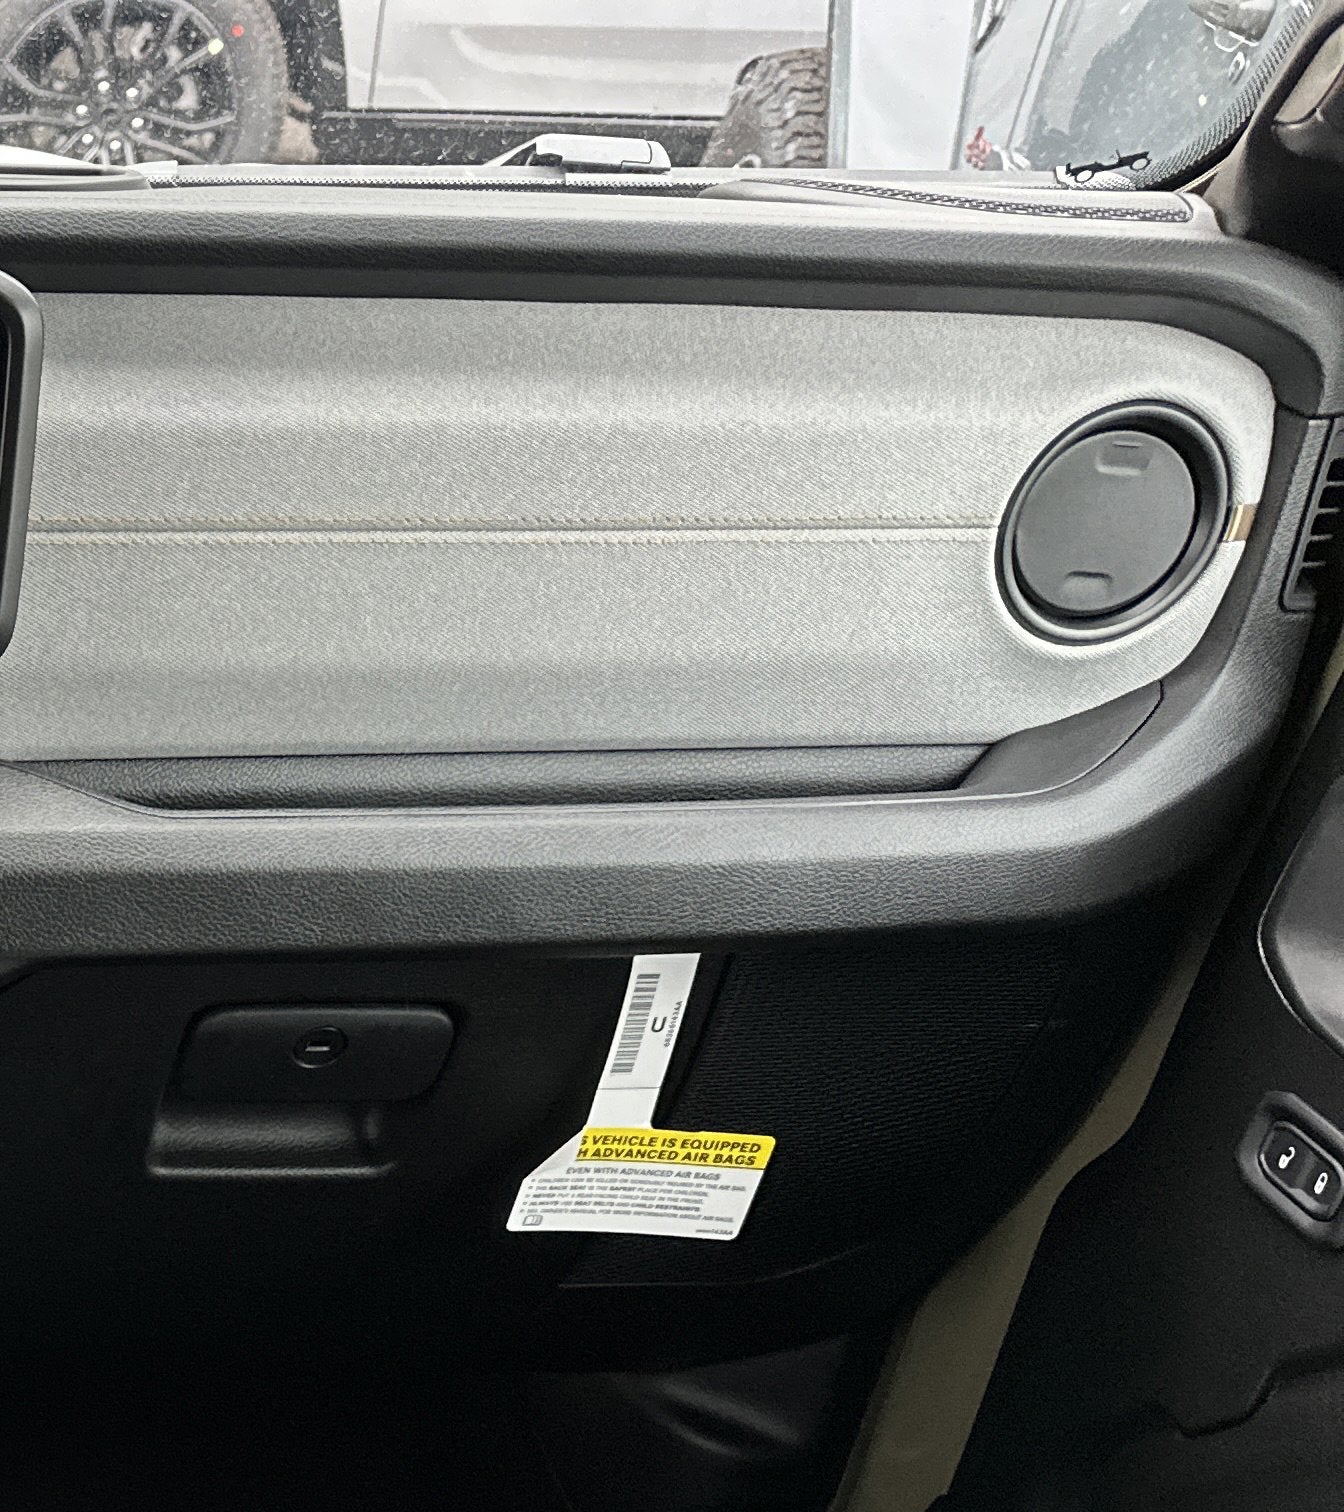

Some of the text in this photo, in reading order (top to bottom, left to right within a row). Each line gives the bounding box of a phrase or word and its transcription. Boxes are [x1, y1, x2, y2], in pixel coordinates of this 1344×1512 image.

[591, 1135, 658, 1147] VEHICLE
[661, 1138, 676, 1148] IS
[680, 1139, 761, 1153] EQUIPPED
[578, 1147, 757, 1166] H ADVANCED AIR BAGS
[566, 1167, 721, 1181] EVEN WITH ADVANCED AIR BAGS
